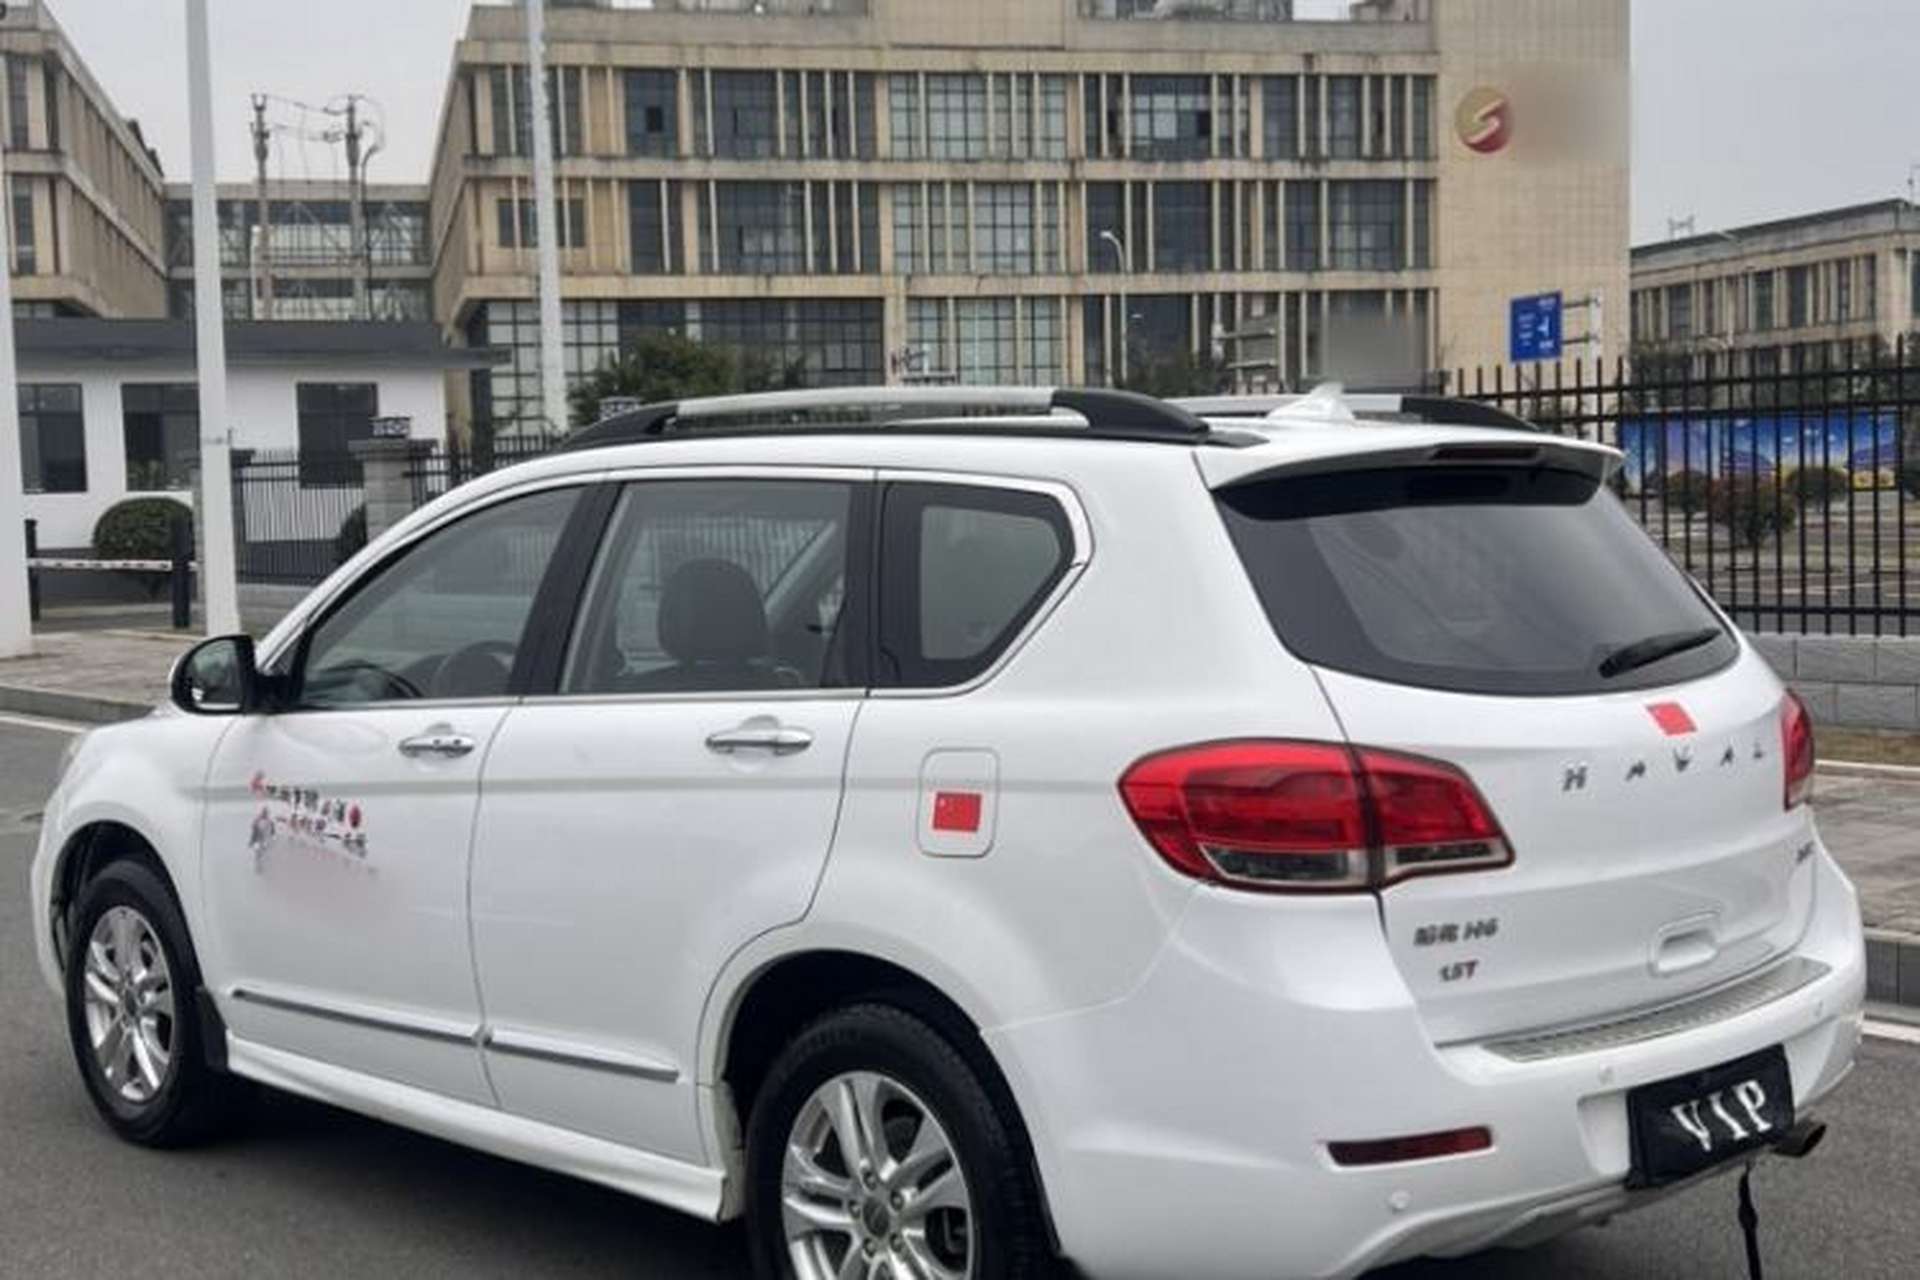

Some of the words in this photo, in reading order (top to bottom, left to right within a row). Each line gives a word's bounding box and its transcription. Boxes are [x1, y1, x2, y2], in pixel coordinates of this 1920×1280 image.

[1563, 745, 1763, 791] HAVAL
[1463, 918, 1498, 941] H6
[1671, 1080, 1772, 1152] VIP
